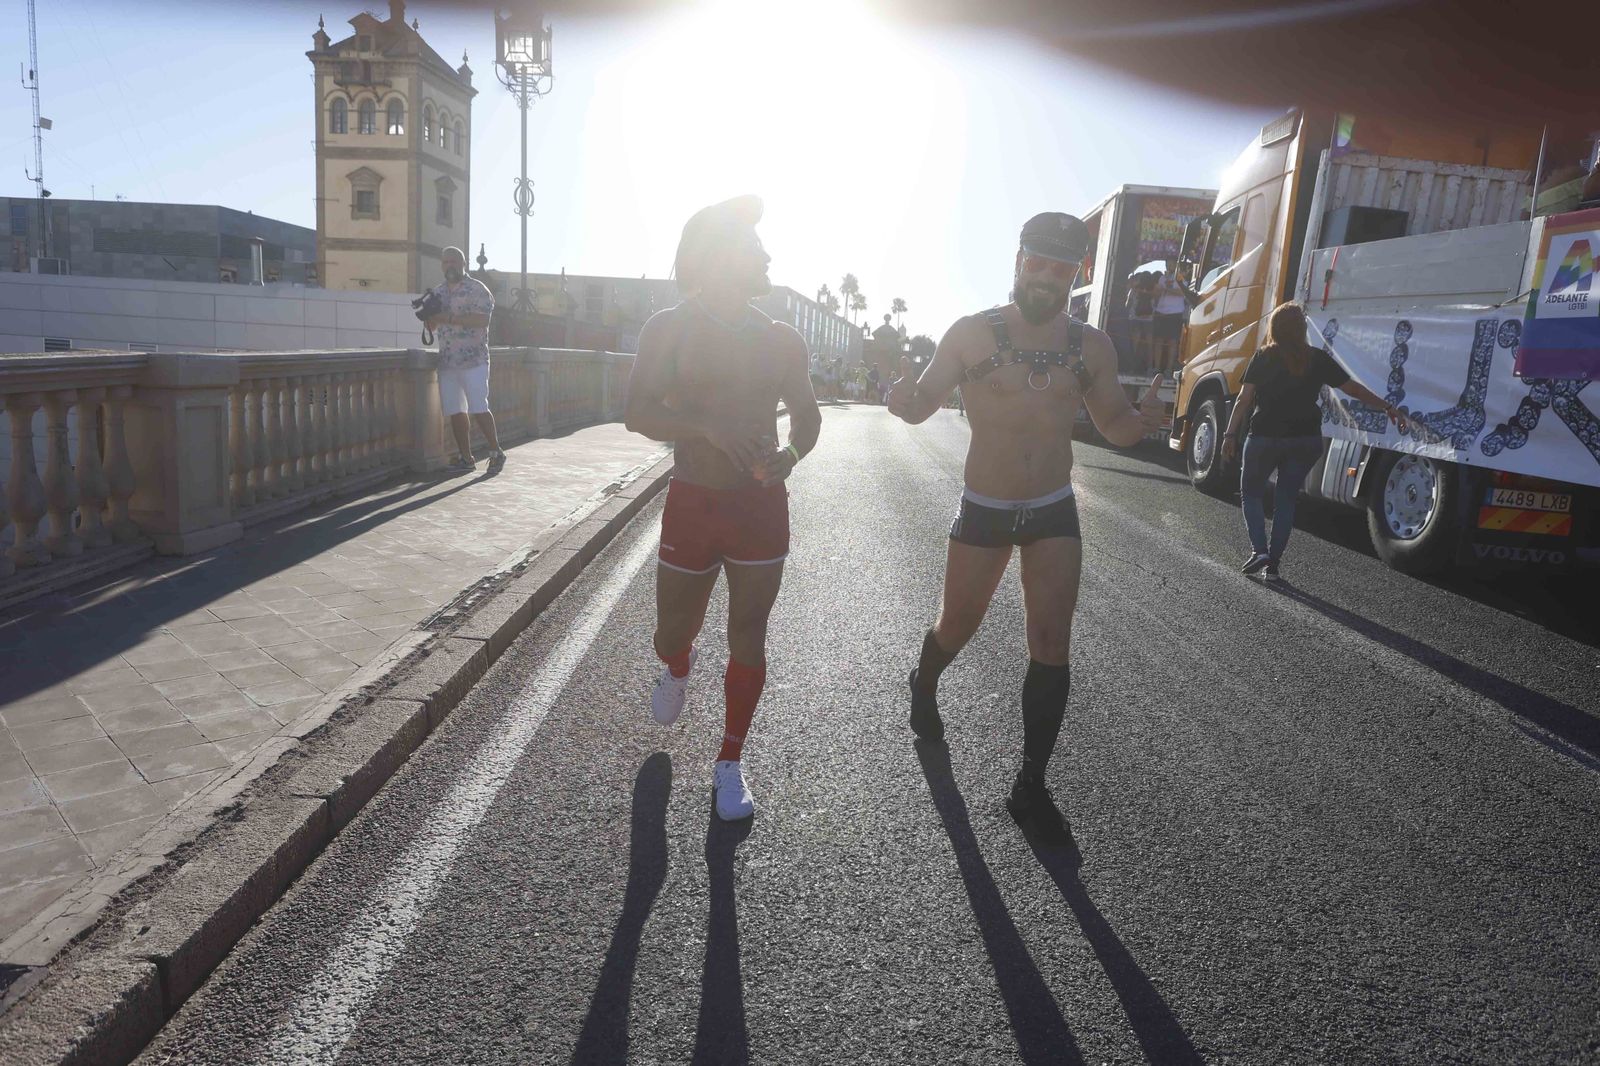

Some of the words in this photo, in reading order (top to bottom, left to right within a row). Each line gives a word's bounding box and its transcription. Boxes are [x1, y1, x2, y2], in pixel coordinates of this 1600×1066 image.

[1545, 293, 1589, 304] ADELANTE
[1568, 302, 1588, 311] LGTBI
[1495, 490, 1535, 508] 4489
[1541, 494, 1569, 510] LXB
[1472, 543, 1567, 565] VOLVO
